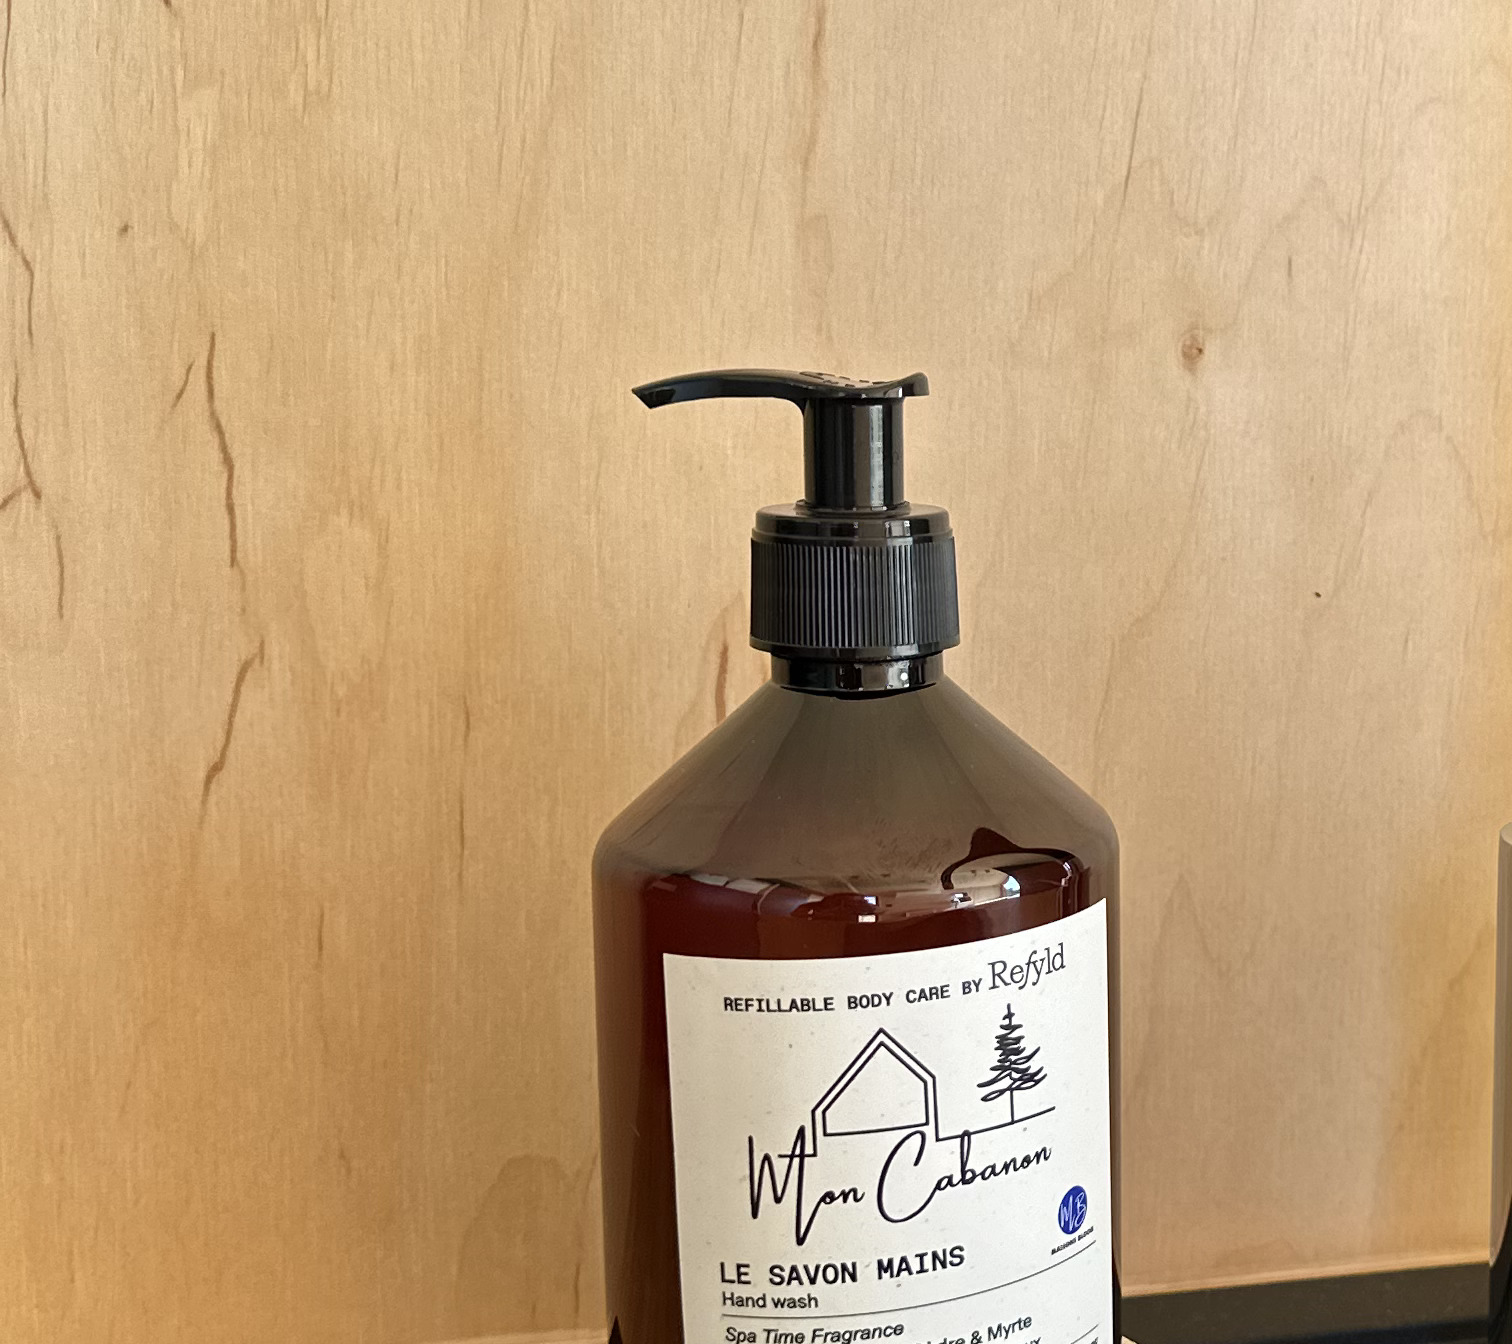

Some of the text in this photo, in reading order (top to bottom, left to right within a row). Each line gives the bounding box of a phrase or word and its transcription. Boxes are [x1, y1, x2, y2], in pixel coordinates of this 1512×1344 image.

[723, 942, 1066, 1012] REFILLABLE BODY CARE BY Refyld
[749, 1124, 1052, 1246] Mon Cabanon
[720, 1245, 966, 1286] LE SAVON MAINS
[722, 1291, 819, 1309] Hand wash
[763, 1327, 806, 1344] Time
[987, 1313, 1033, 1344] Myrte
